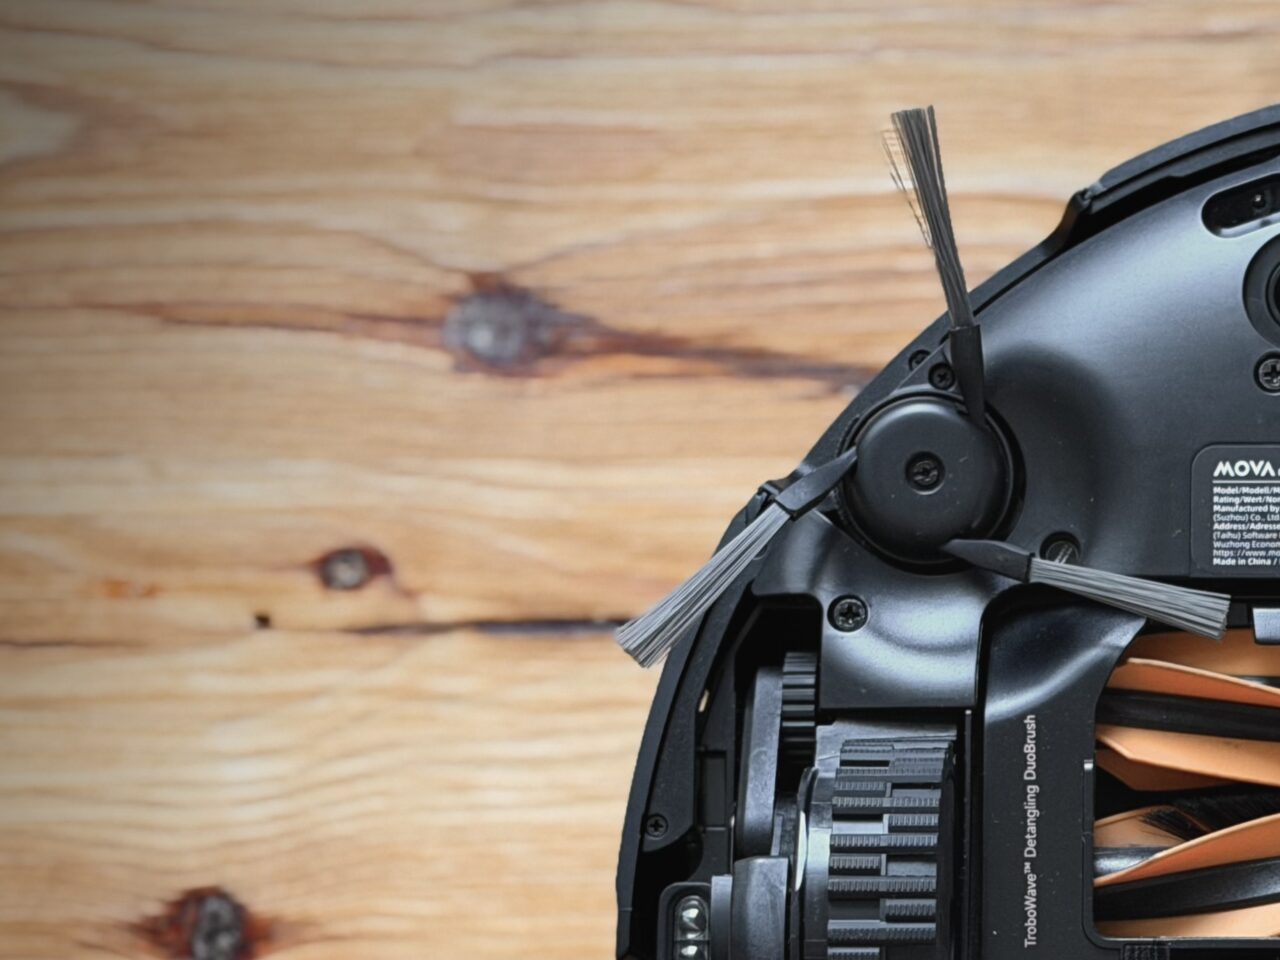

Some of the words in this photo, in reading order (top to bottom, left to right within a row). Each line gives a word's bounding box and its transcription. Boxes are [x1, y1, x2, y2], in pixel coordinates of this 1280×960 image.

[1212, 460, 1275, 477] MOVA
[1212, 504, 1268, 512] Manufactured
[1212, 513, 1249, 522] (Suzhou)
[1266, 512, 1280, 521] Ltd.
[1212, 531, 1241, 540] (Taihu)
[1241, 530, 1278, 539] Software
[1212, 540, 1250, 549] Wuzhong
[1212, 557, 1236, 565] Made
[1237, 557, 1246, 565] in
[1246, 556, 1271, 565] China
[1023, 714, 1037, 780] DuoBrush
[1023, 785, 1039, 858] Detangling
